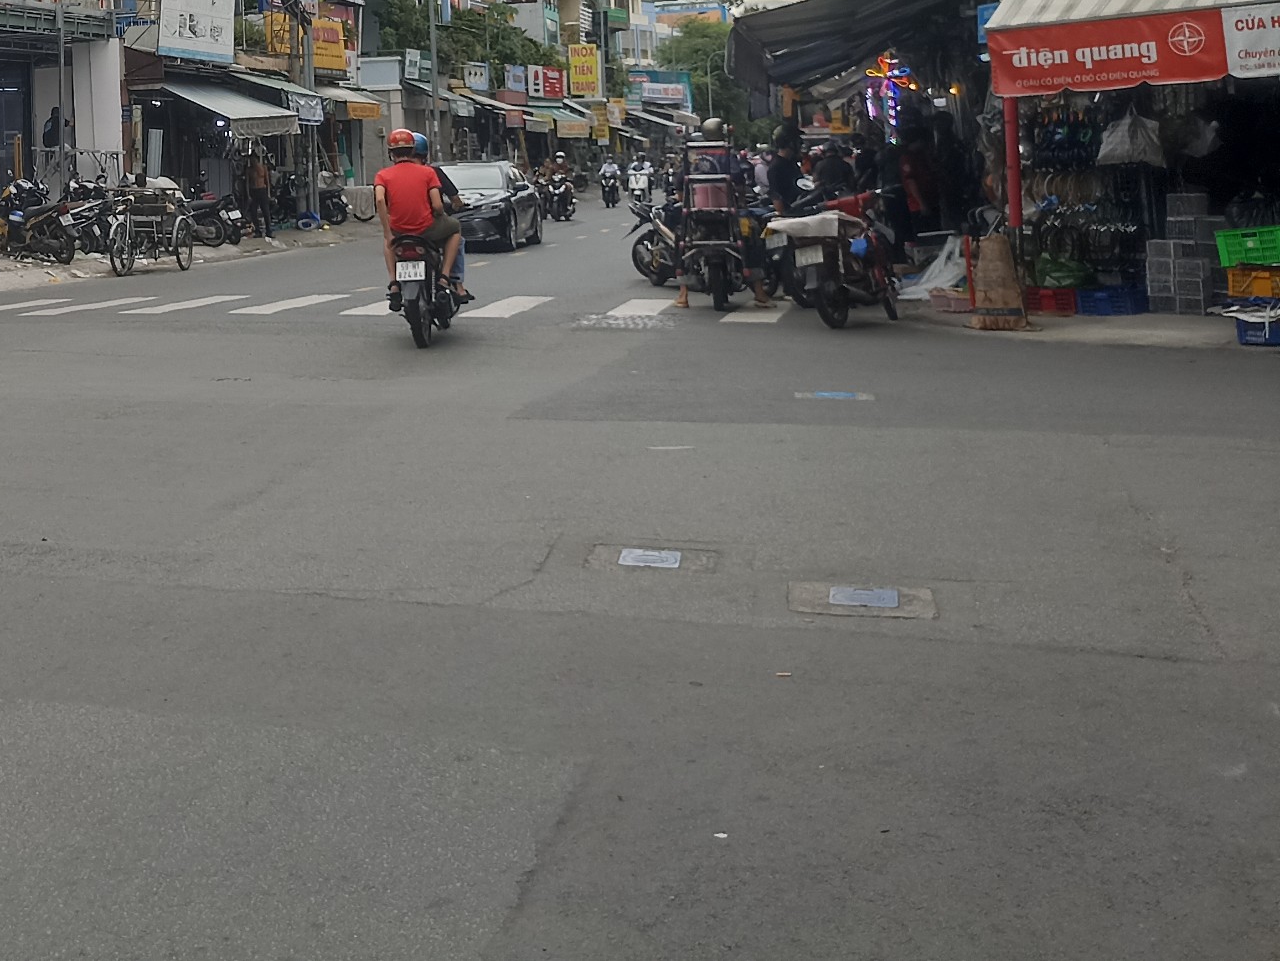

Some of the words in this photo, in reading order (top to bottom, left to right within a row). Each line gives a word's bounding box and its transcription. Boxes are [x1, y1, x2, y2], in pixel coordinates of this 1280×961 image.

[1234, 13, 1267, 32] CỬA
[570, 46, 595, 57] INOX
[1003, 47, 1069, 69] điện
[1075, 41, 1158, 69] quang
[573, 61, 593, 75] TIẾN
[572, 81, 596, 92] TRANG
